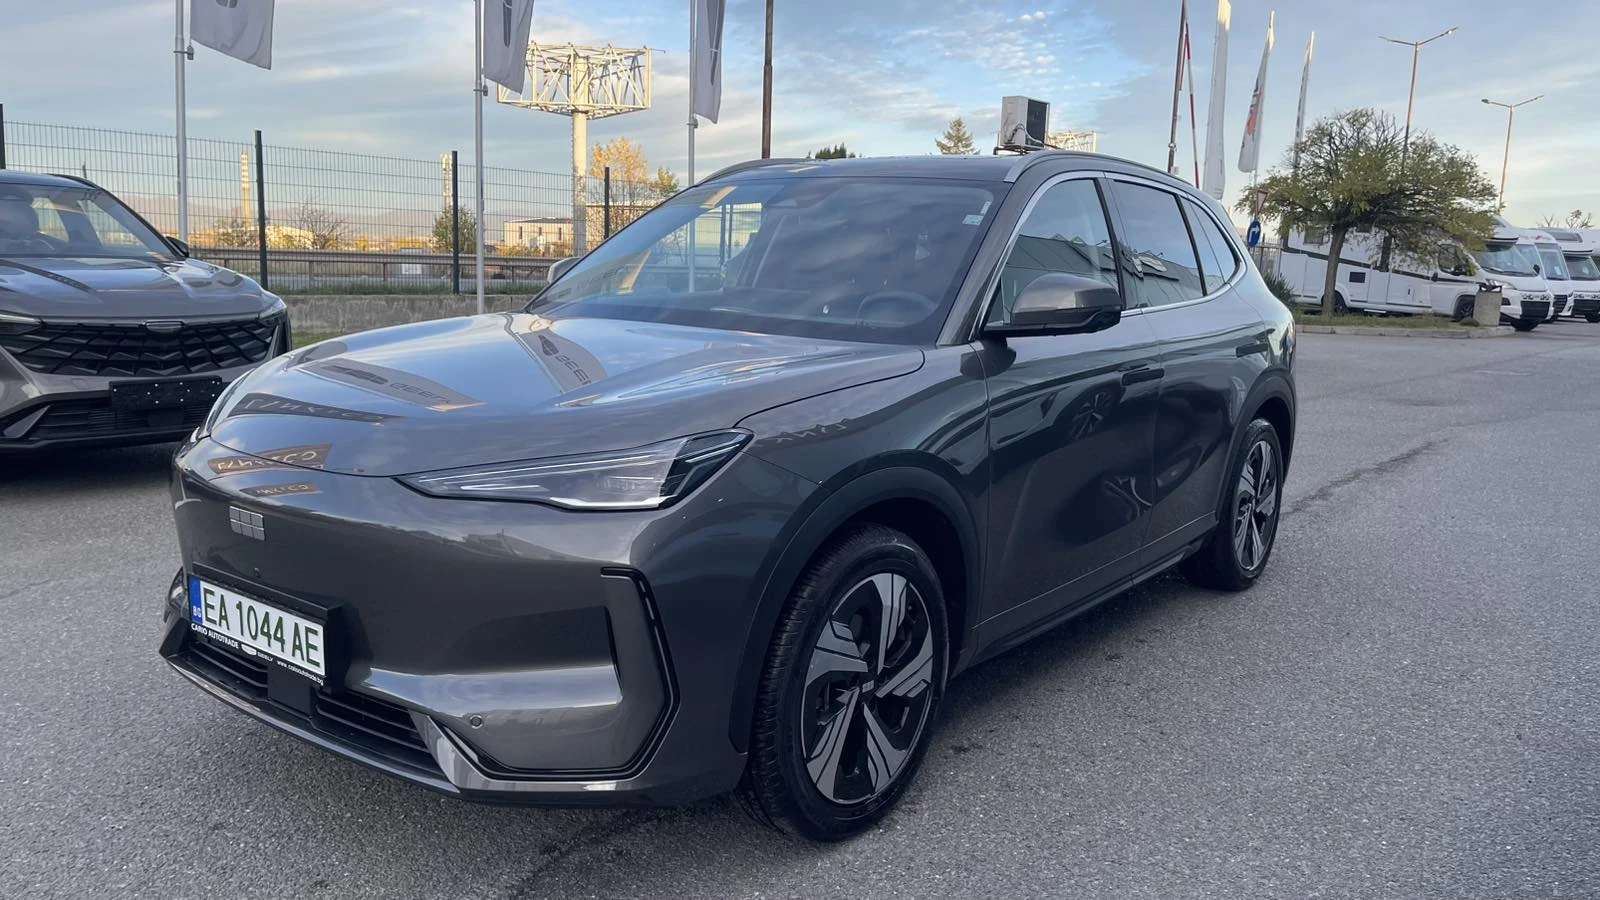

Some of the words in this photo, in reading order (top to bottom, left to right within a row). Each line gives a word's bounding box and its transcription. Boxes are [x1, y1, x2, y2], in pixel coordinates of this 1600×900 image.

[193, 605, 202, 618] BG
[203, 587, 230, 631] EA
[236, 601, 285, 652] 1044
[292, 622, 321, 668] AE
[208, 630, 239, 649] AUTOTRADE
